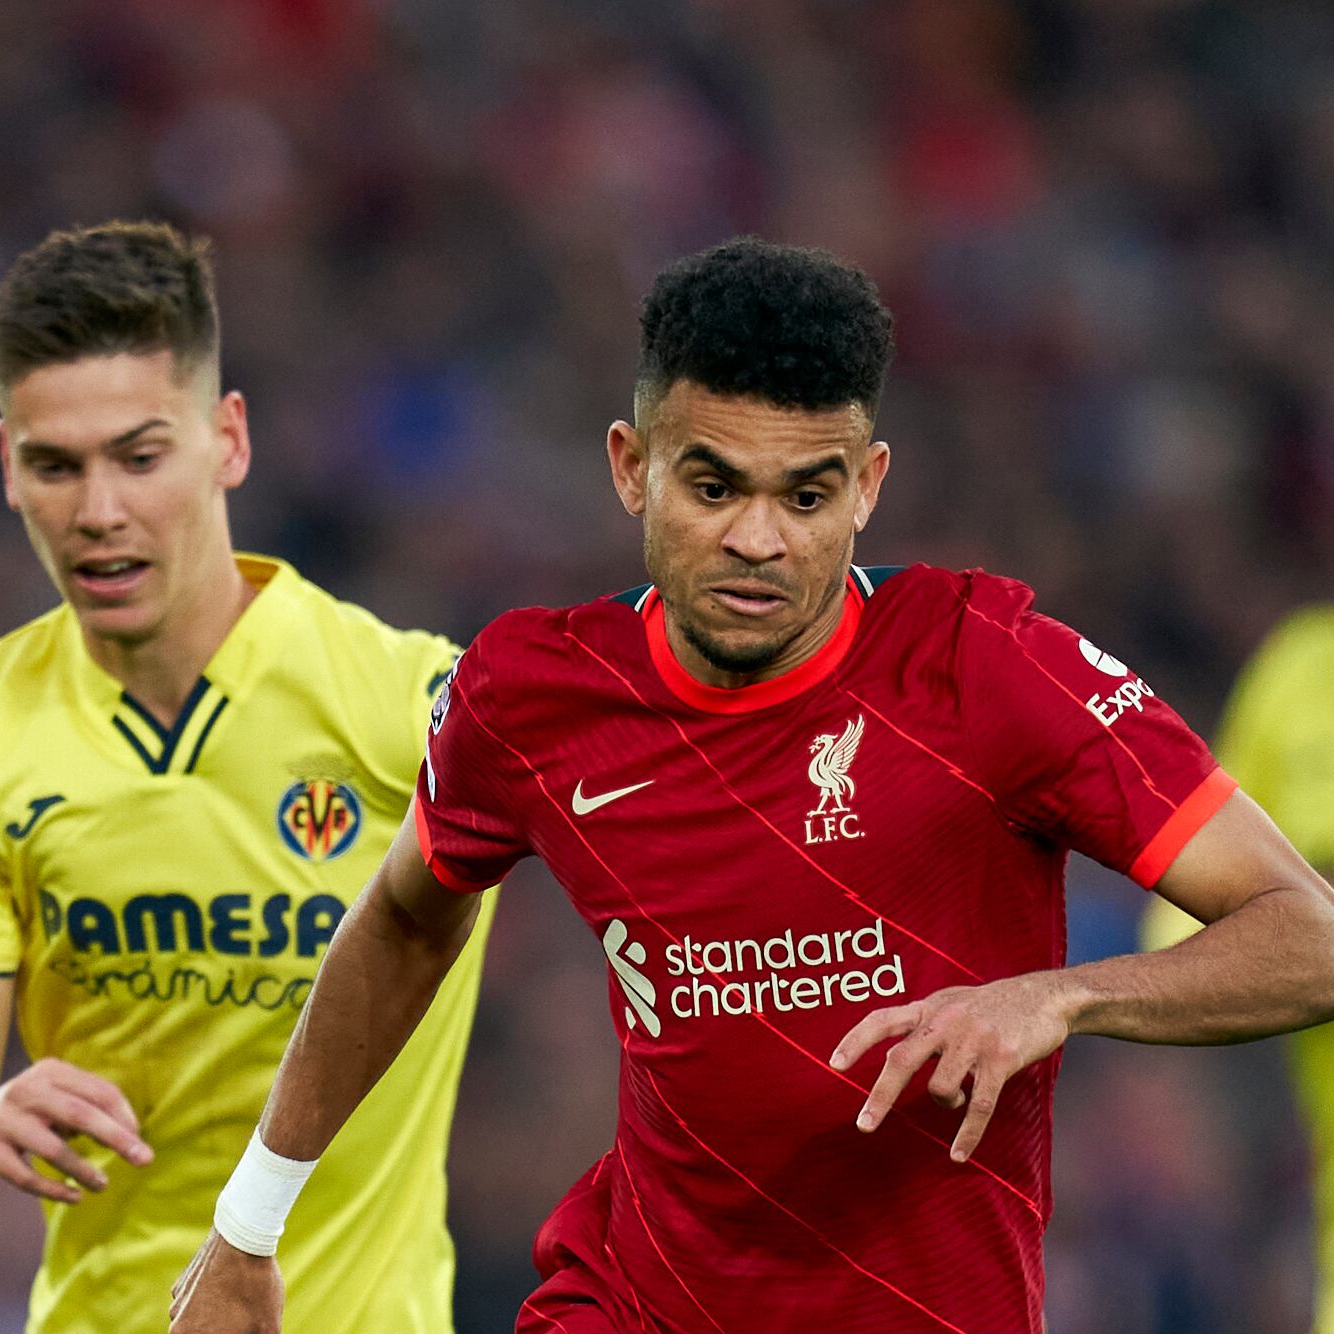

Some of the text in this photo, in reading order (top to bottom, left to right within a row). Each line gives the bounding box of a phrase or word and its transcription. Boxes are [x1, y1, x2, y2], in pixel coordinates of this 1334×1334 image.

[804, 814, 866, 845] L.F.C.
[39, 888, 348, 958] PAMESA
[666, 917, 886, 977] standard
[671, 954, 906, 1018] chartered
